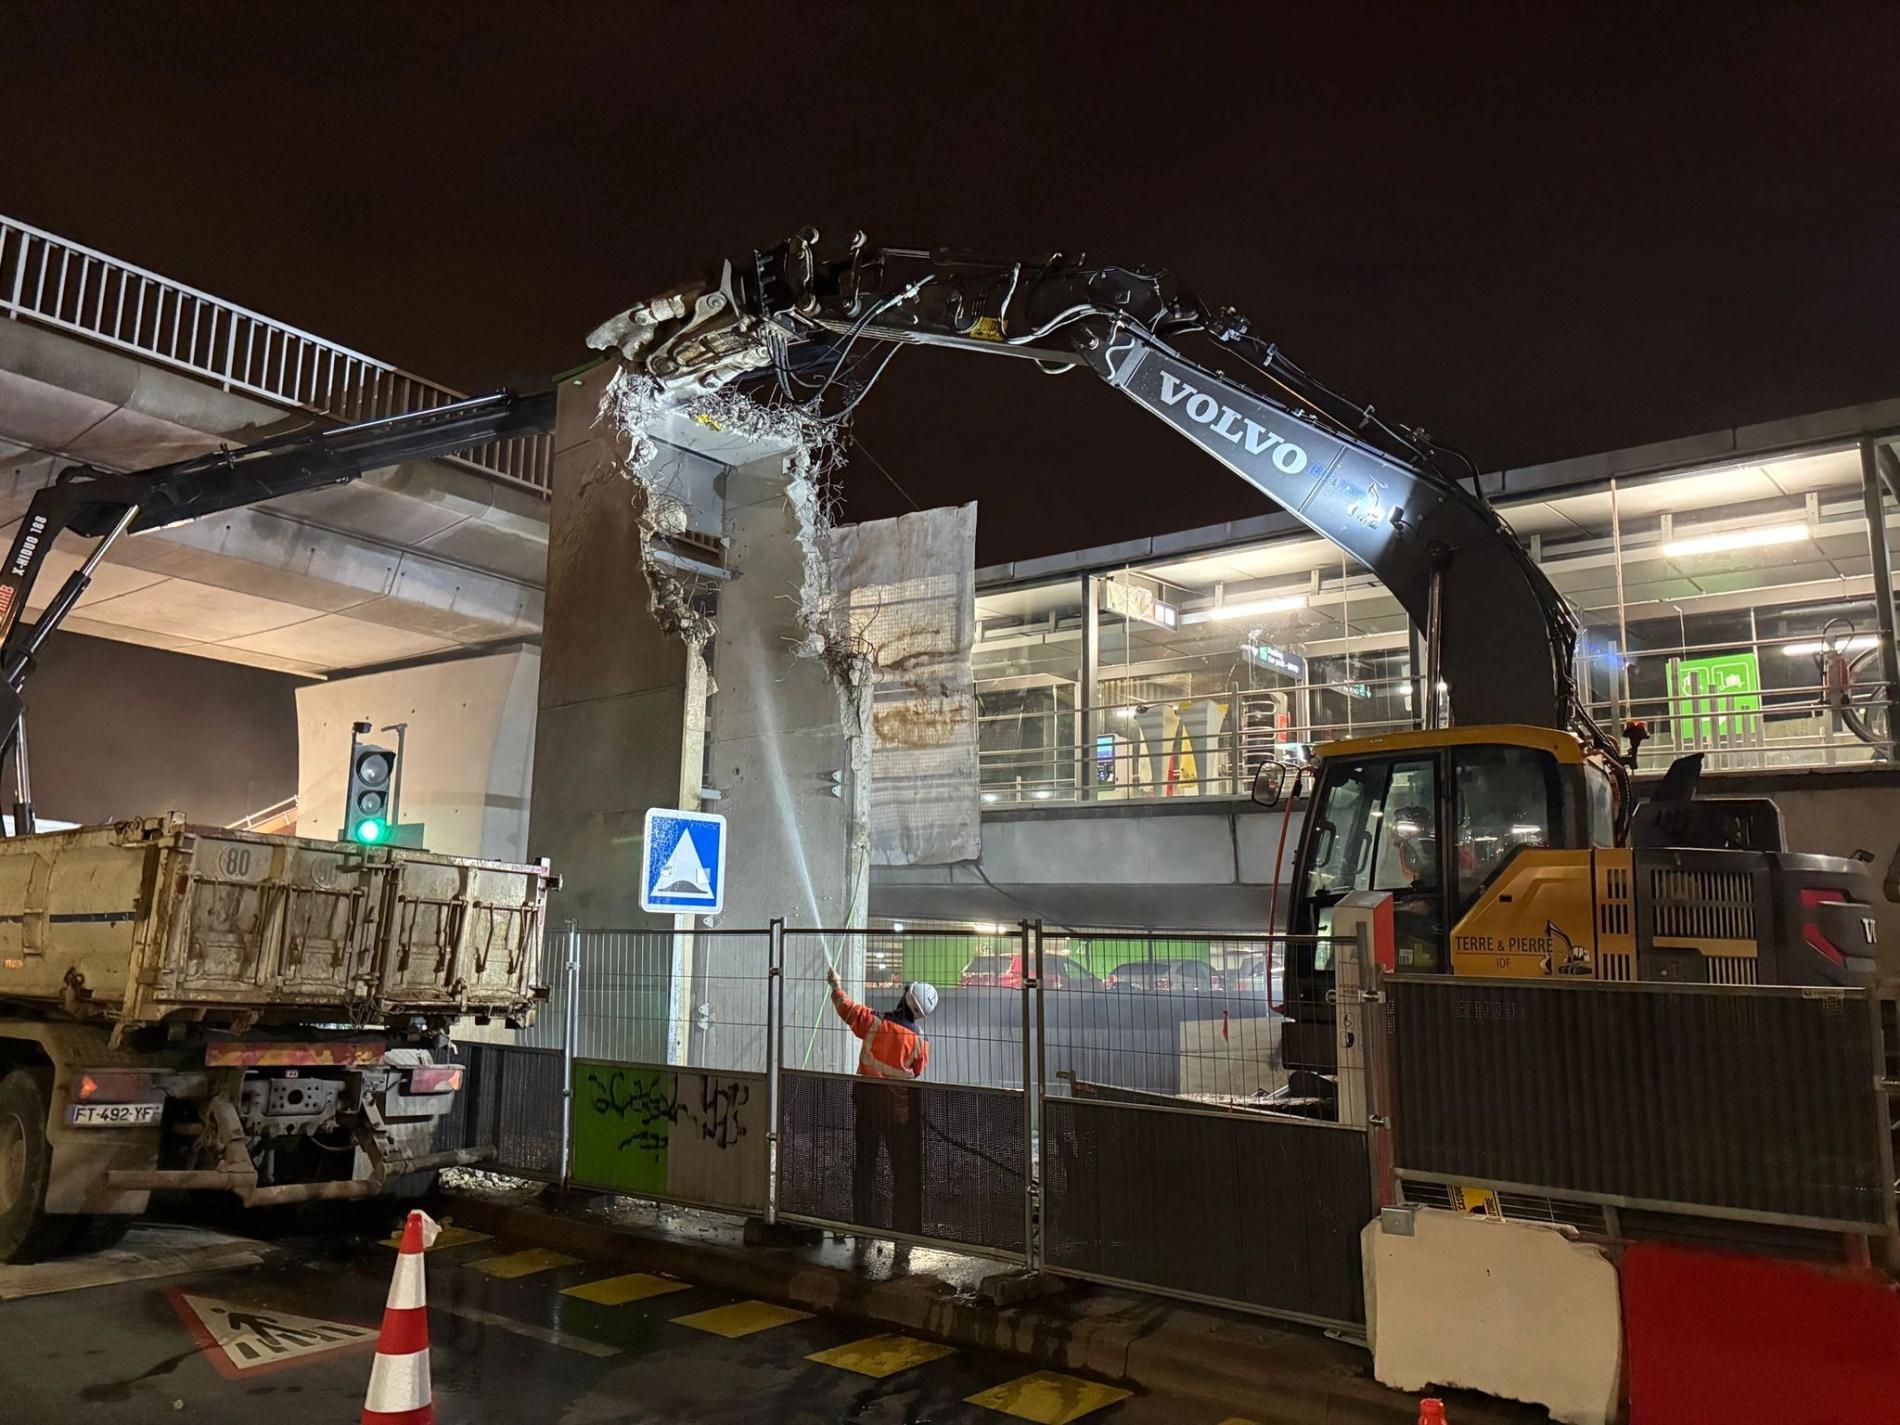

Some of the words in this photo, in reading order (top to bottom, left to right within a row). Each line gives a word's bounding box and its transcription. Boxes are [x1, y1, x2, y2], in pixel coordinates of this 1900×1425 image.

[1159, 370, 1309, 474] VOLVO
[30, 515, 47, 535] 188
[227, 847, 250, 876] 80
[1455, 936, 1493, 951] TERRE
[1497, 939, 1505, 952] &
[1508, 937, 1553, 953] PIERRE
